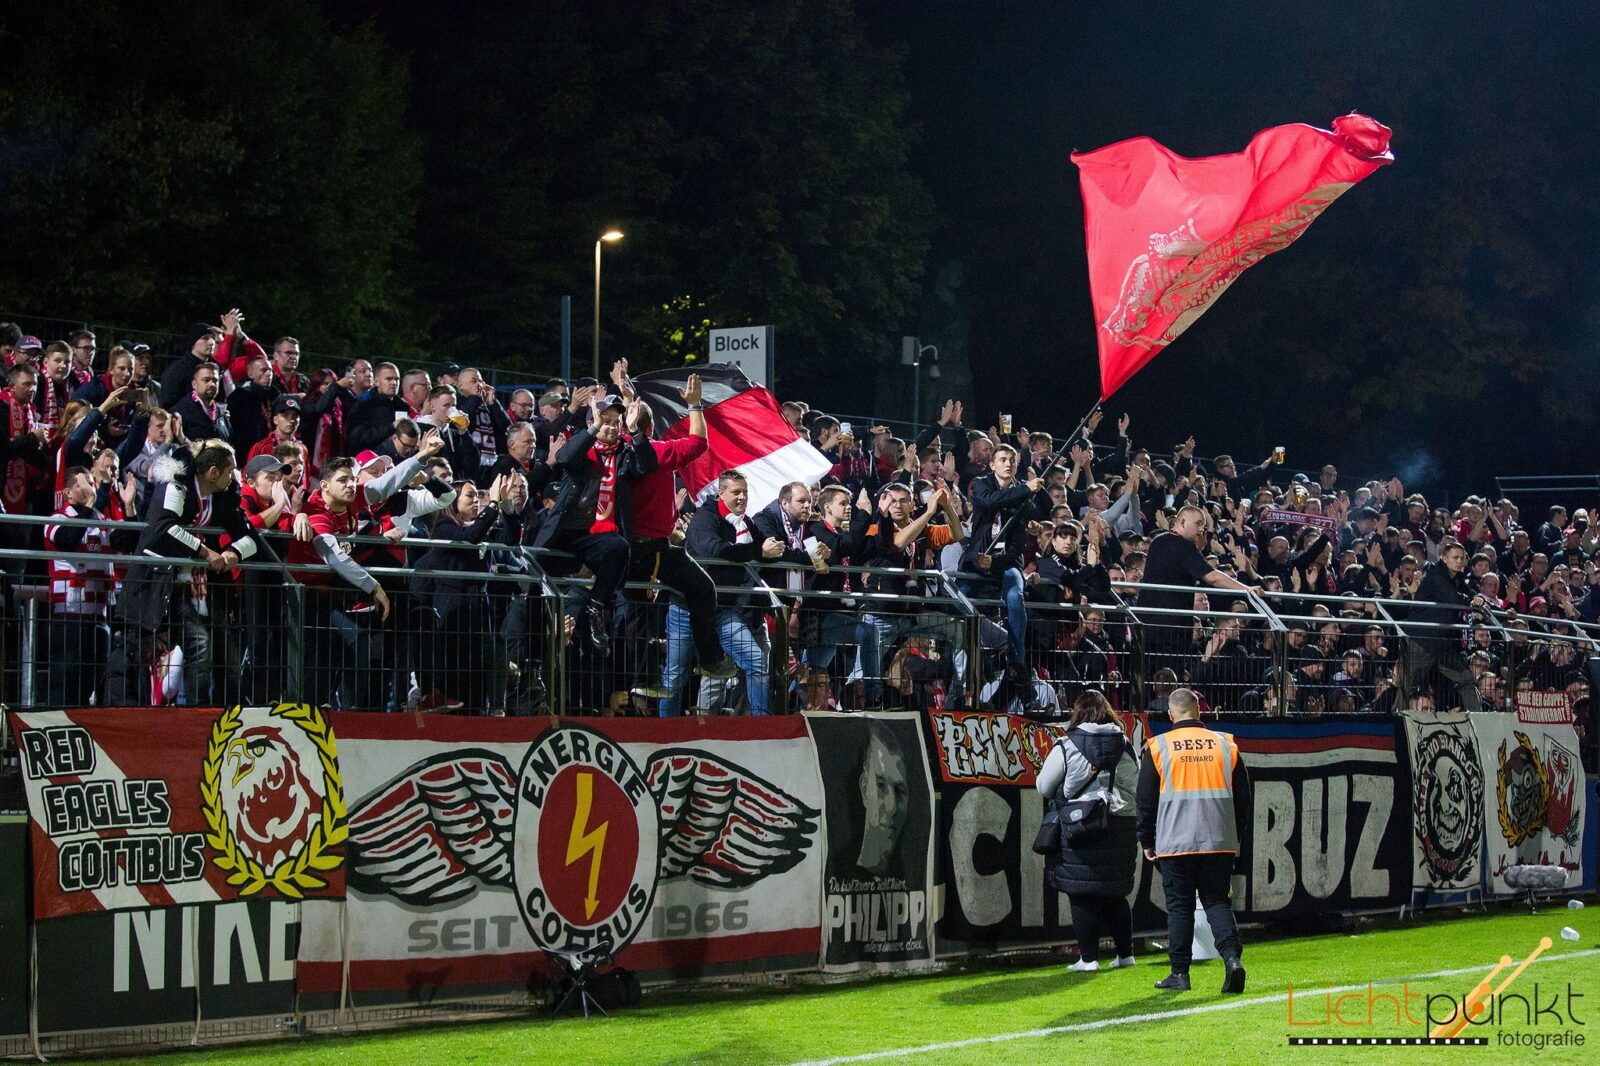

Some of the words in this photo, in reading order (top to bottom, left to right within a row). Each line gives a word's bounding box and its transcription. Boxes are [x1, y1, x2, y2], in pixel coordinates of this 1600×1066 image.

[715, 334, 759, 351] Block
[1532, 692, 1543, 706] DER
[22, 728, 96, 779] RED
[522, 730, 648, 810] ENERGIE
[43, 780, 172, 836] EAGLES
[59, 834, 205, 892] COTTBUS
[407, 914, 518, 953] SEIT
[526, 883, 648, 959] COTTBUS
[652, 901, 749, 939] 1966
[826, 890, 926, 944] PHILIPP
